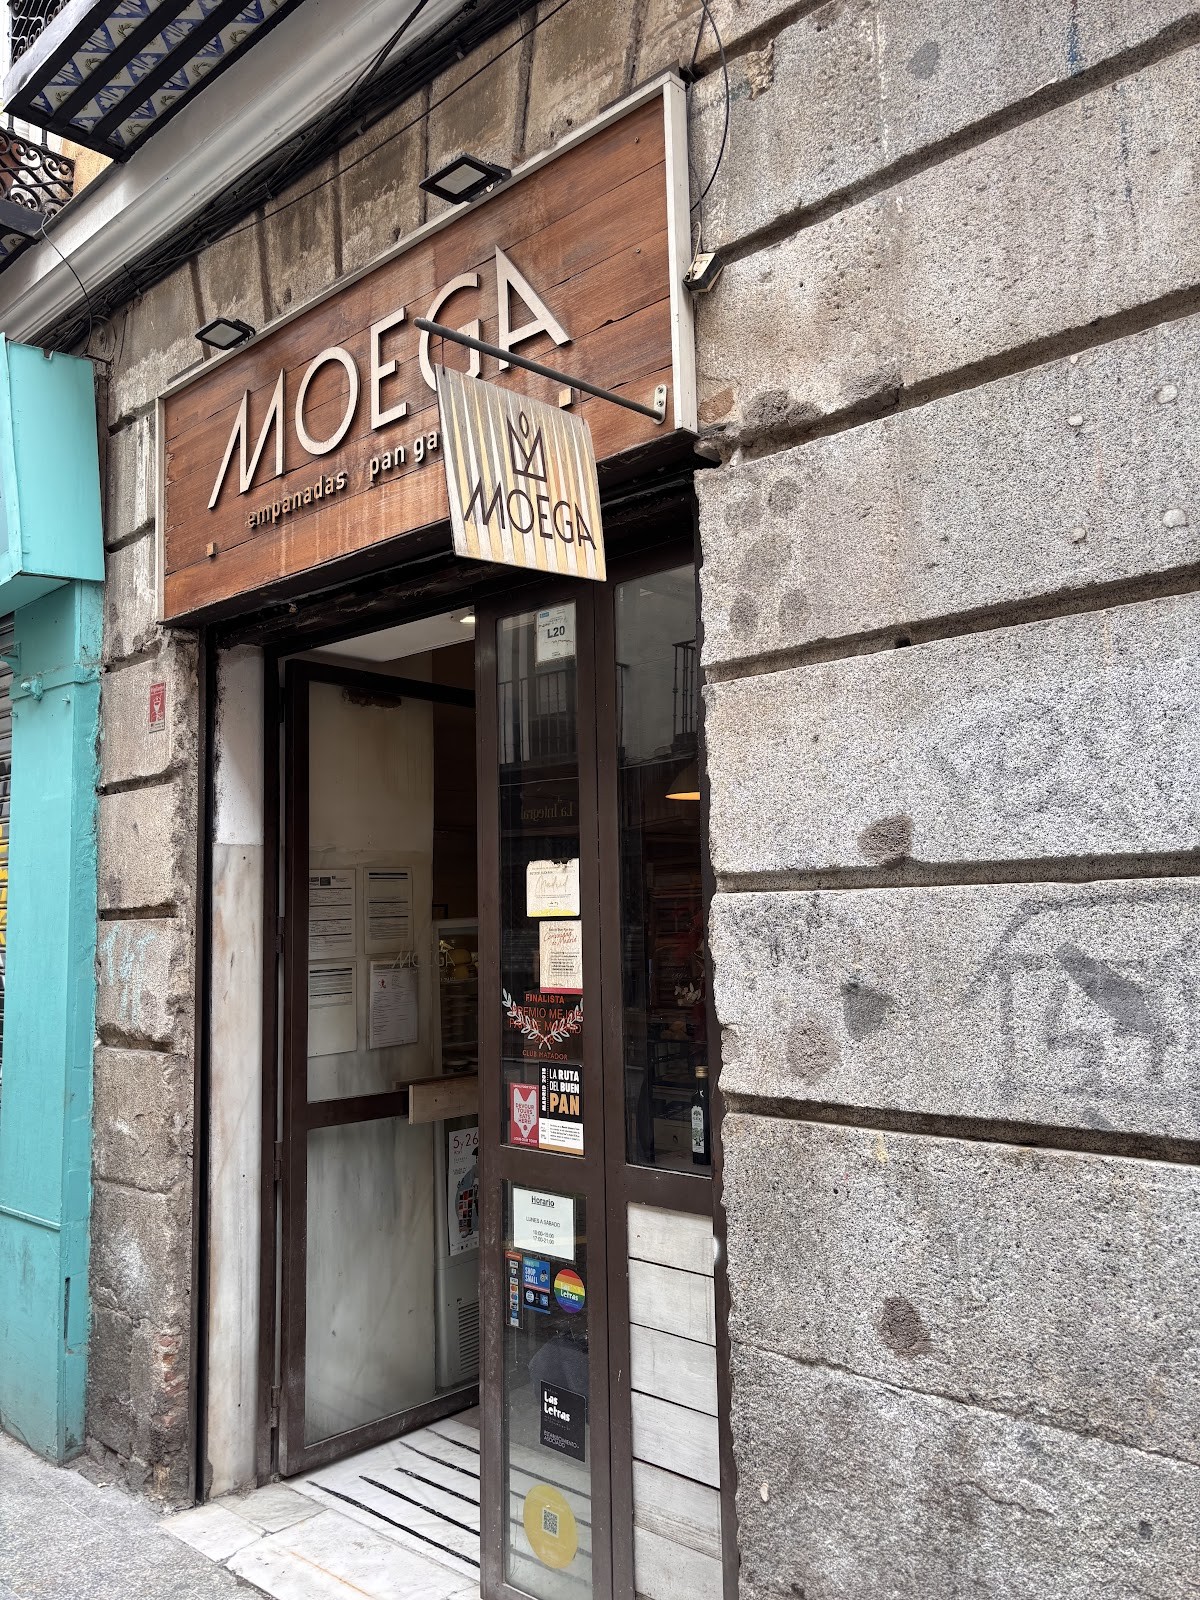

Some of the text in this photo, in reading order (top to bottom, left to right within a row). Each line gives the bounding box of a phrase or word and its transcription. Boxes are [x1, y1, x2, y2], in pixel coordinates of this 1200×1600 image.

[207, 244, 573, 511] MOEGA
[246, 431, 439, 529] empanadas pan ga
[463, 476, 597, 551] MOEGA
[547, 625, 566, 639] L20
[525, 993, 565, 1004] FINALISTA
[512, 1004, 546, 1019] PREMIO
[544, 1021, 582, 1034] MRID
[534, 1034, 555, 1045] 208
[522, 1049, 568, 1061] CLUB MATADOR
[549, 1067, 580, 1082] LA RUTA
[549, 1080, 560, 1092] DEL
[560, 1081, 580, 1094] BUEN
[515, 1102, 535, 1110] DEVOUR
[549, 1092, 580, 1117] PAN
[531, 1195, 555, 1208] Horario
[526, 1216, 540, 1224] LUNES
[524, 1266, 537, 1276] SHOP
[524, 1274, 539, 1285] SMALL
[560, 1288, 579, 1302] Letras
[543, 1390, 559, 1406] Las
[543, 1402, 571, 1422] Letras
[543, 1435, 566, 1449] ASOCIADO
